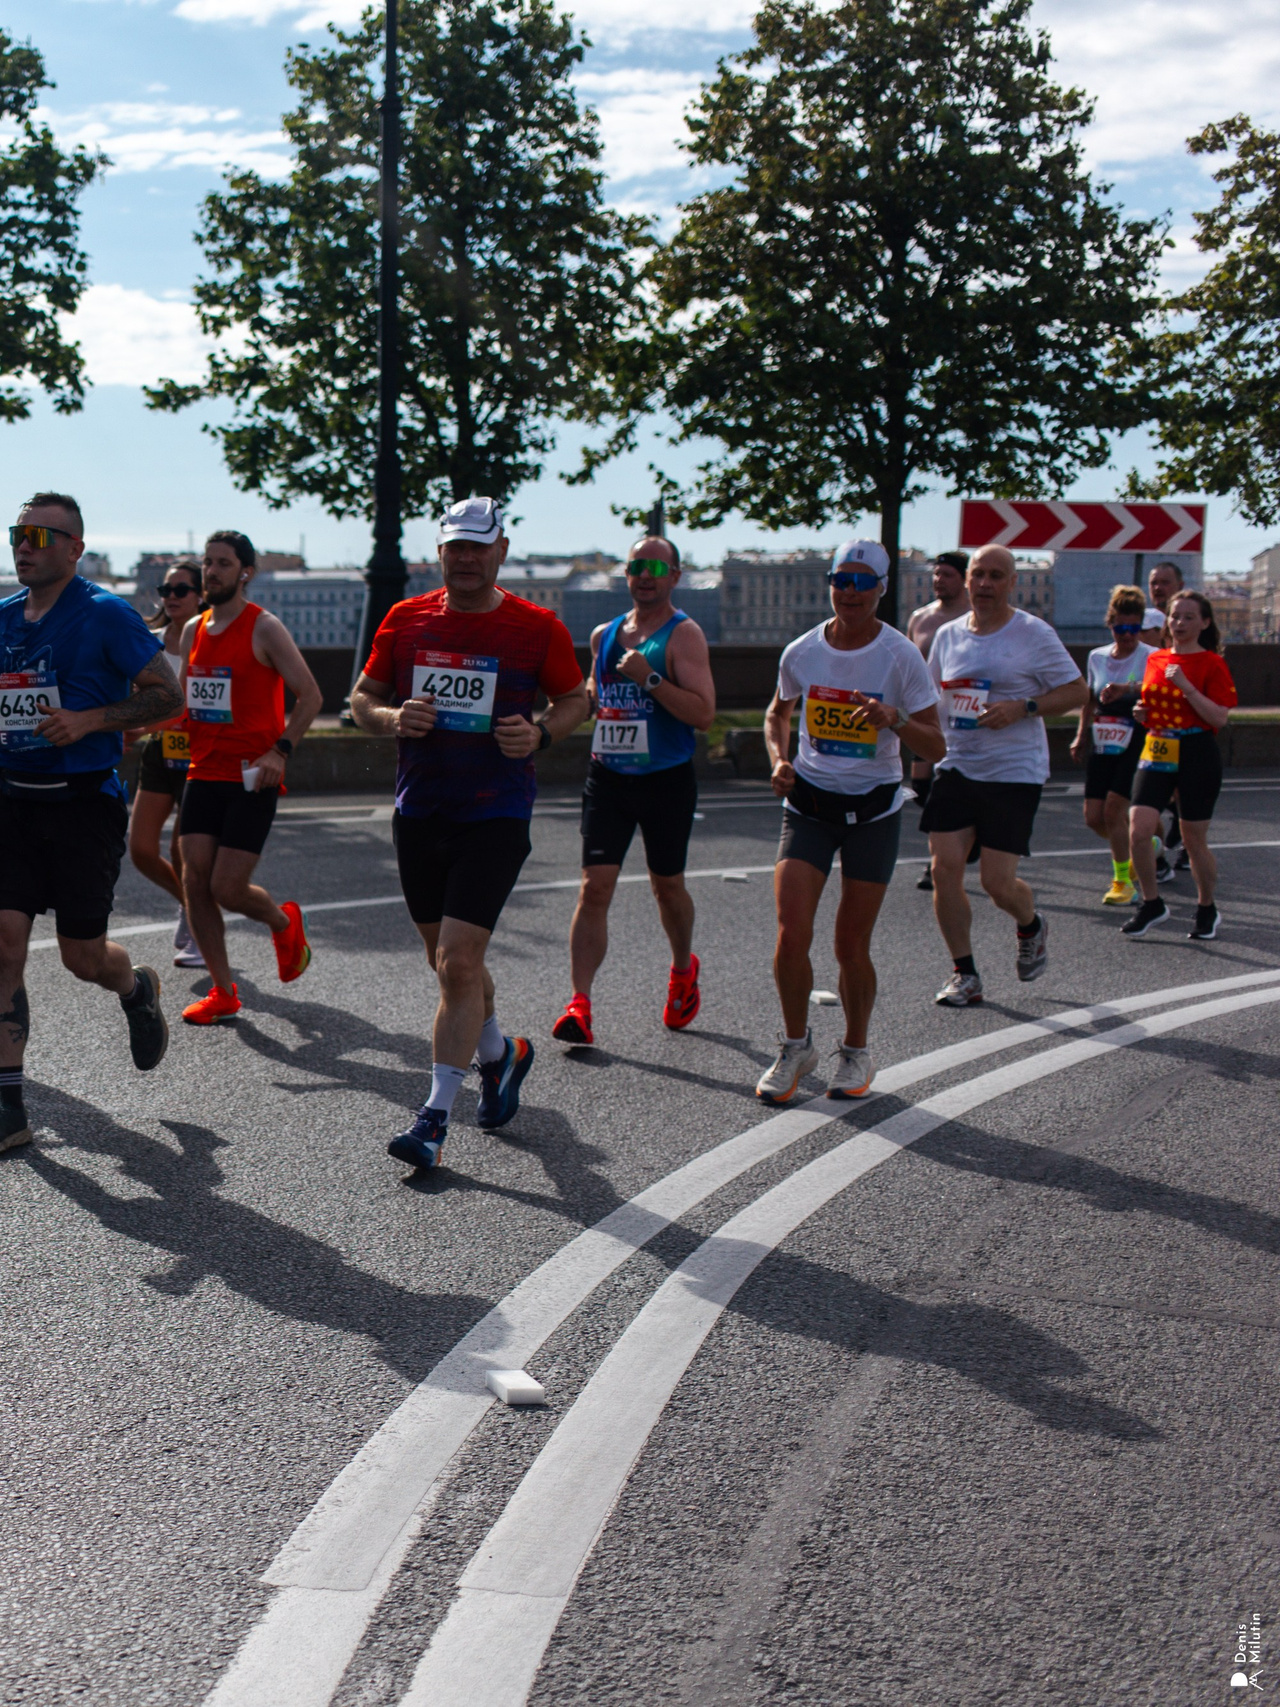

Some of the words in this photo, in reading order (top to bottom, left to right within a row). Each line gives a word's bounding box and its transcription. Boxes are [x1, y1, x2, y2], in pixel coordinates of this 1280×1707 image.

[191, 681, 225, 700] 3637
[422, 673, 485, 701] 4208
[0, 693, 51, 718] 6430
[433, 699, 474, 709] ЛАДИМИР
[0, 732, 8, 745] E
[600, 724, 638, 744] 1177
